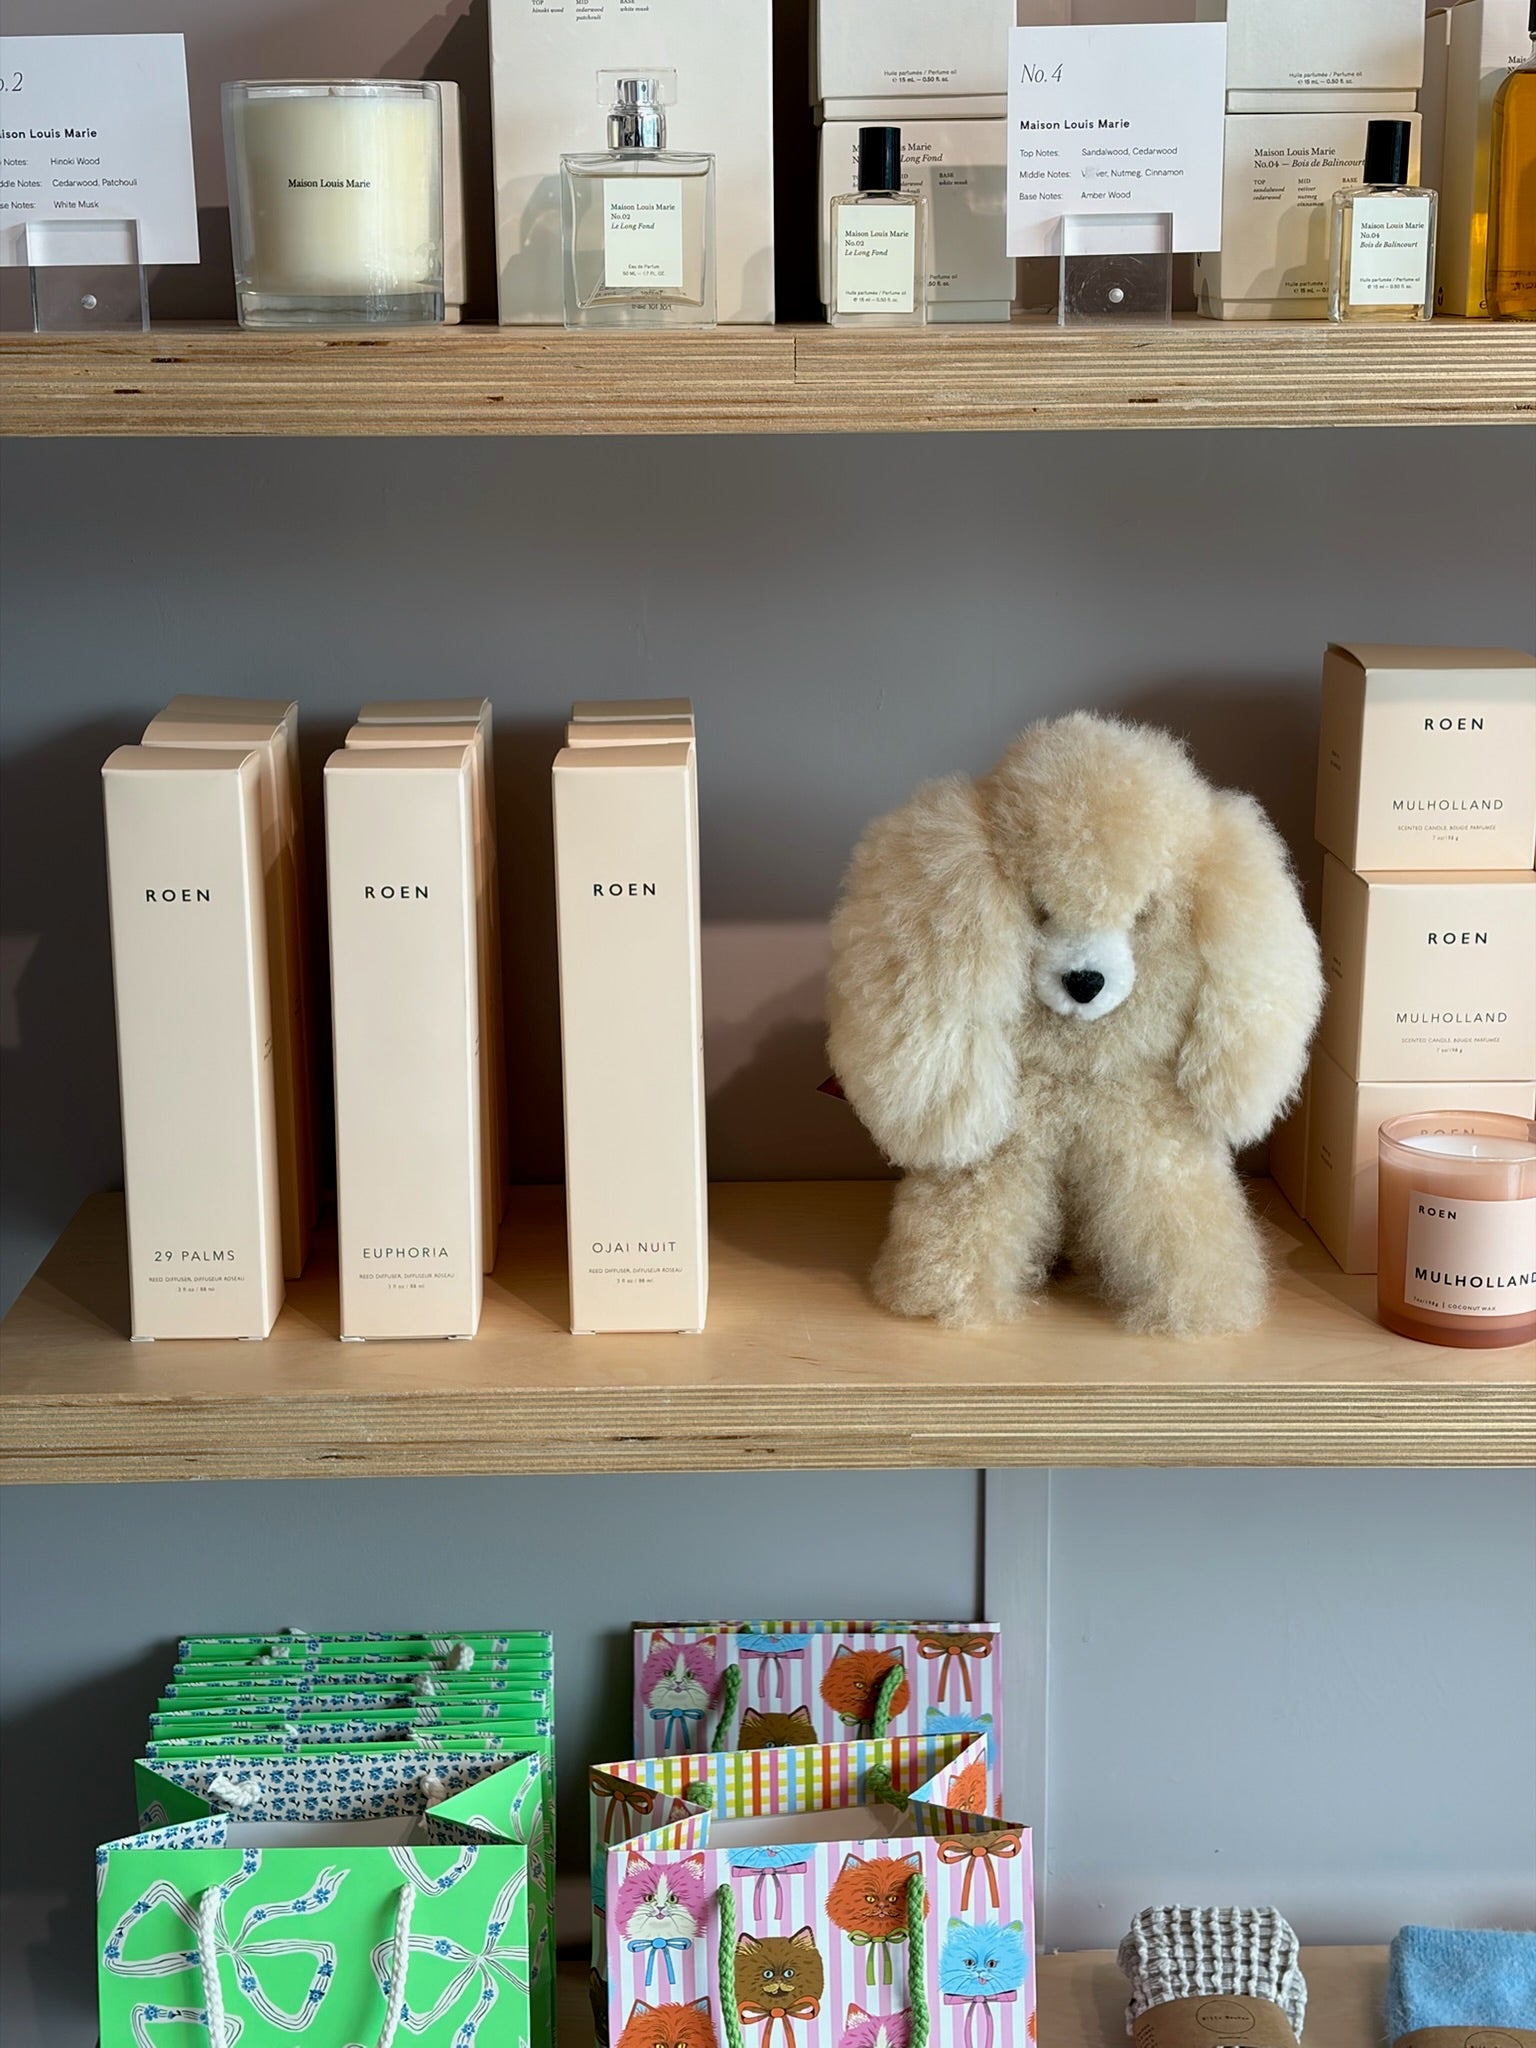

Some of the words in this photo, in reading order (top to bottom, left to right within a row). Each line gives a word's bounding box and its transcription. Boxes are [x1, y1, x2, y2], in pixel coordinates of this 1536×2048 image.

[1020, 120, 1060, 130] Maison
[1064, 119, 1094, 129] Louis
[1098, 118, 1130, 129] Marie
[30, 128, 61, 139] Louis
[64, 128, 97, 139] Marie
[908, 143, 932, 151] Marie
[1020, 150, 1034, 158] Top
[1035, 149, 1059, 157] Notes:
[1081, 148, 1130, 156] Sandalwood,
[1133, 147, 1178, 155] Cedarwood
[1254, 148, 1285, 157] Maison
[1287, 148, 1310, 156] Louis
[1311, 147, 1336, 155] Marie
[50, 157, 75, 165] Hinoki
[76, 157, 100, 165] Wood
[922, 154, 943, 162] Fond
[1292, 160, 1309, 168] Bois
[1019, 171, 1046, 179] Middle
[1111, 169, 1143, 179] Nutmeg,
[1145, 168, 1184, 177] Cinnamon
[17, 180, 42, 188] Notes:
[52, 179, 100, 188] Cedarwood,
[102, 178, 138, 187] Patchouli
[288, 179, 318, 188] Maison
[320, 179, 344, 188] Louis
[346, 179, 371, 188] Marie
[1019, 193, 1037, 201] Base
[1039, 192, 1063, 200] Notes:
[1081, 191, 1106, 199] Amber
[1108, 191, 1131, 199] Wood
[11, 201, 36, 209] Notes:
[853, 249, 870, 257] Long
[1424, 718, 1484, 731] ROEN
[1393, 799, 1504, 811] MULHOLLAND
[365, 886, 428, 899] ROEN
[593, 883, 656, 896] ROEN
[145, 889, 210, 902] ROEN
[1428, 932, 1487, 944] ROEN
[1396, 1012, 1508, 1023] MULHOLLAND
[1418, 1205, 1457, 1220] ROEN
[592, 1242, 629, 1253] OJAI
[638, 1241, 676, 1252] NUIT
[154, 1251, 173, 1262] 29
[181, 1250, 235, 1261] PALMS
[363, 1247, 448, 1259] EUPHORIA
